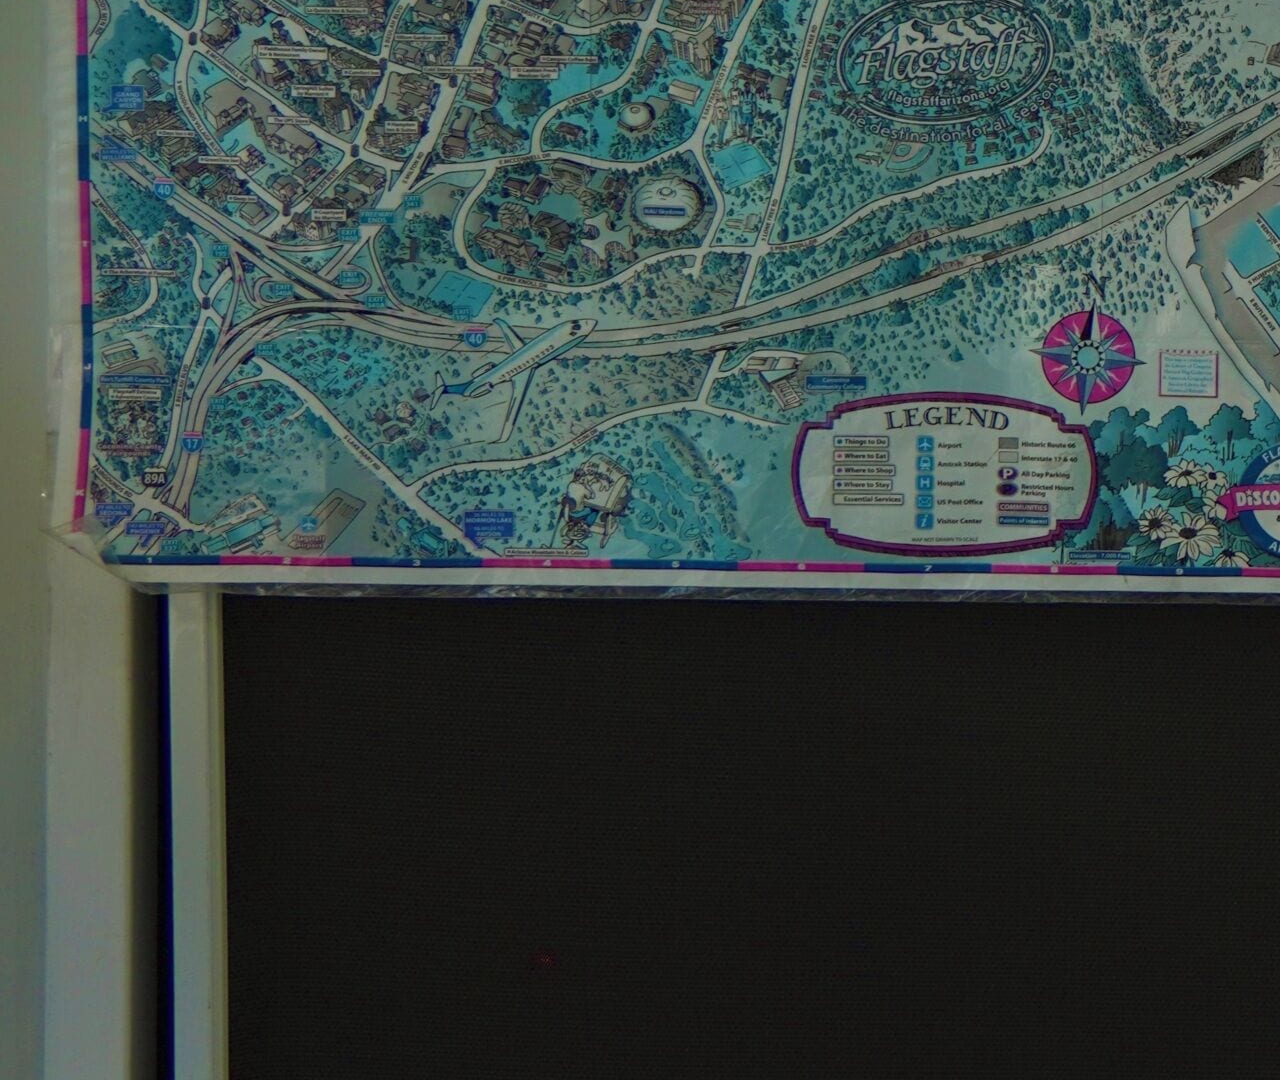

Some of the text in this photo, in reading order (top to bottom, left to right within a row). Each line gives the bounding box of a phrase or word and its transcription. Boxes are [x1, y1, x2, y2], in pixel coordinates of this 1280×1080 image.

[856, 26, 1031, 88] Flagstaff
[887, 79, 1011, 107] flagstaffarizona.org
[871, 121, 961, 144] destination
[963, 124, 990, 141] for
[992, 113, 1014, 133] all
[1013, 76, 1063, 121] seasons
[884, 406, 1010, 431] LEGEND
[937, 480, 965, 488] Hospital
